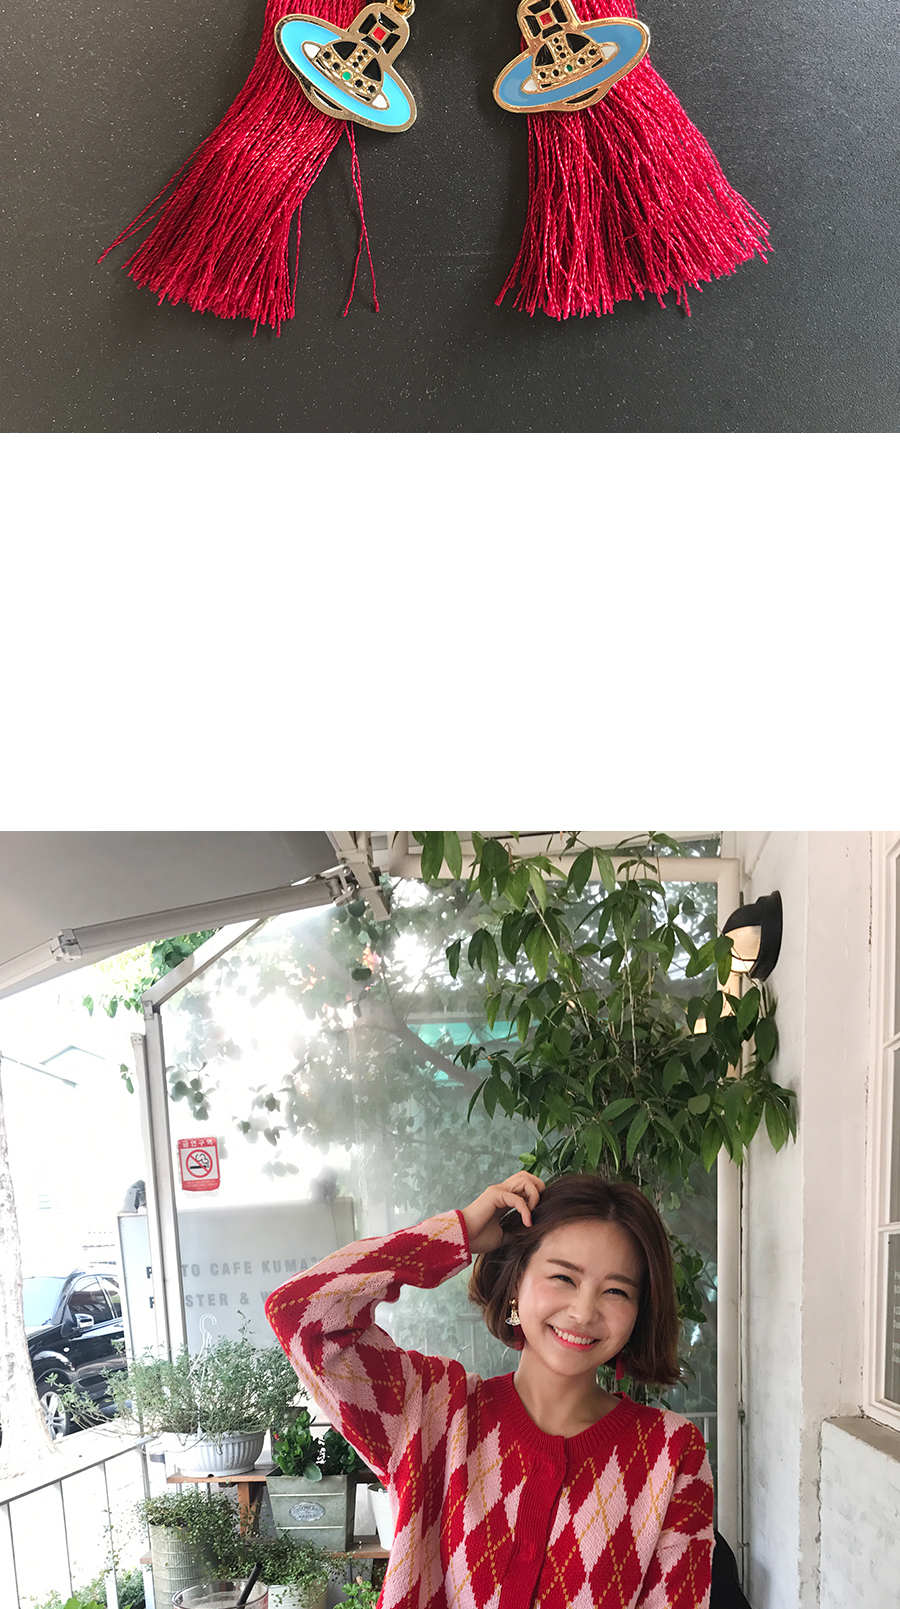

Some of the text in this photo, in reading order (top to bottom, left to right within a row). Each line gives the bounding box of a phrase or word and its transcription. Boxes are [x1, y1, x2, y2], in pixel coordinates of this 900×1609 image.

[182, 1139, 213, 1148] 금연구역
[210, 1261, 252, 1276] CAFE
[239, 1292, 250, 1305] &
